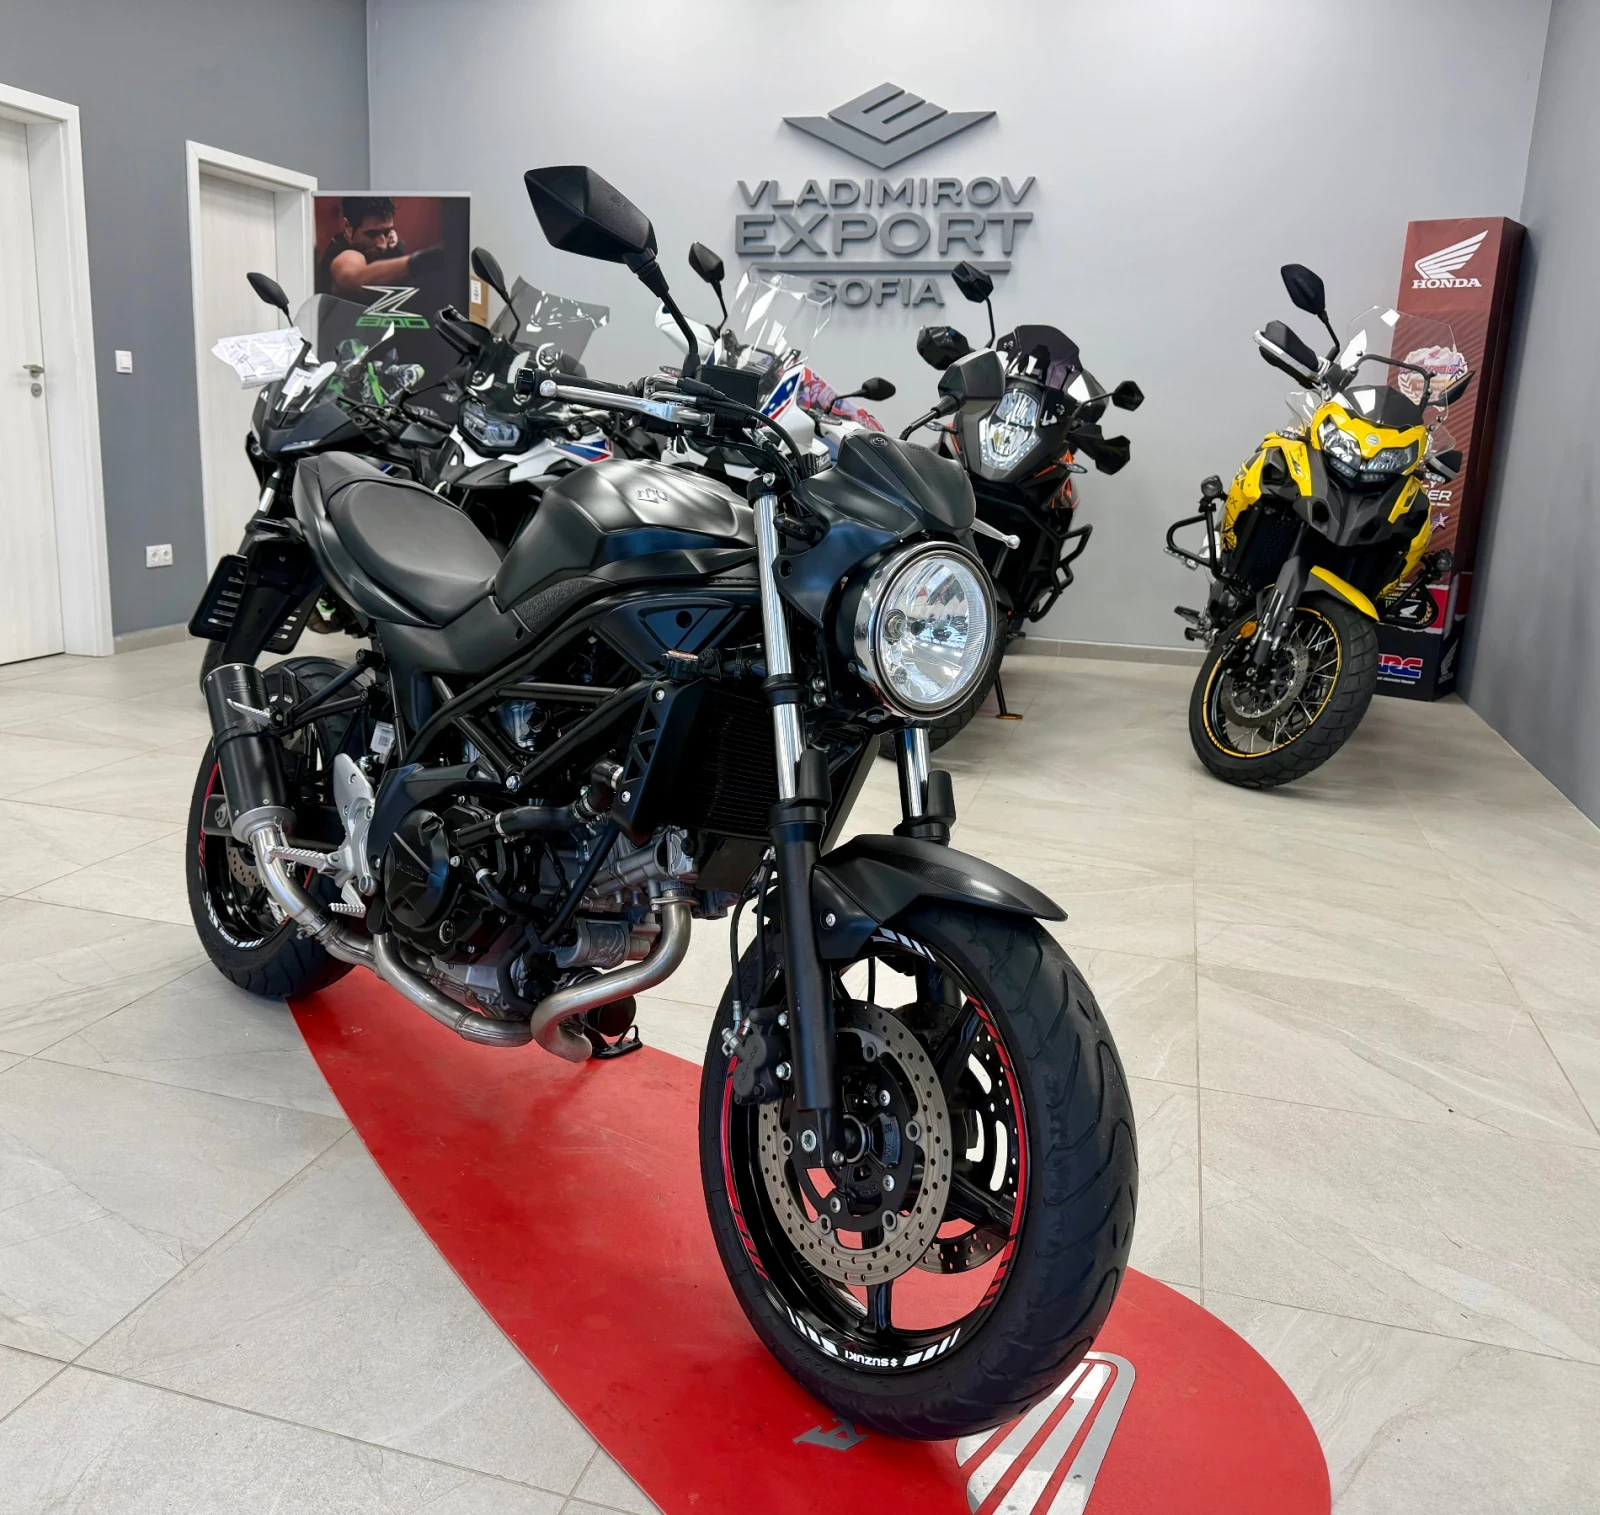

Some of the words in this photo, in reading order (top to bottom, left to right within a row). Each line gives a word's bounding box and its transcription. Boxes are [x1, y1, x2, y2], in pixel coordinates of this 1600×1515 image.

[737, 176, 1036, 207] VLADIMIROV
[735, 211, 1034, 255] EXPORT
[810, 277, 945, 306] SOFIA
[1412, 277, 1482, 289] HONDA
[845, 1350, 889, 1367] SUZUKI
